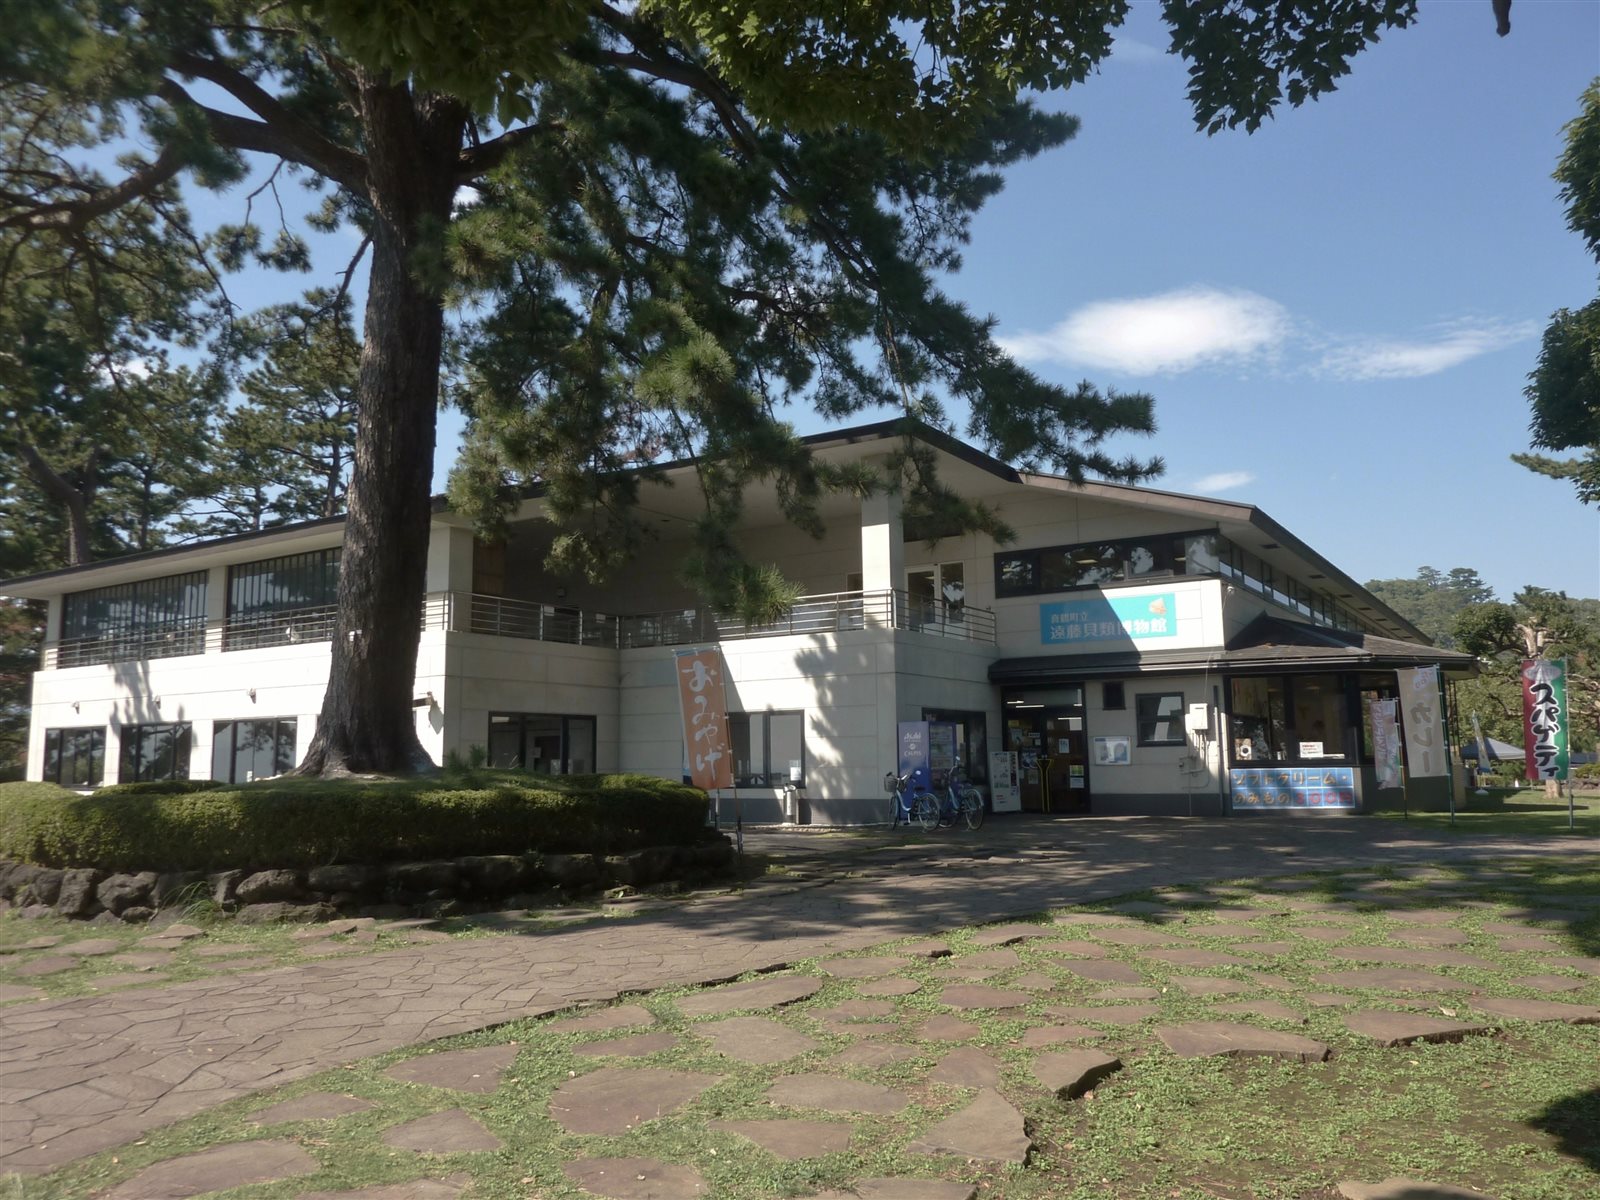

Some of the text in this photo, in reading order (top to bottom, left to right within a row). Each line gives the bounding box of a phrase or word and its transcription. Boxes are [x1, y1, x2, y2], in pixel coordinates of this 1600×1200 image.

[1050, 618, 1167, 640] 遠藤貝類博物館
[681, 660, 722, 781] おみやげ
[1530, 683, 1560, 776] スパゲティ
